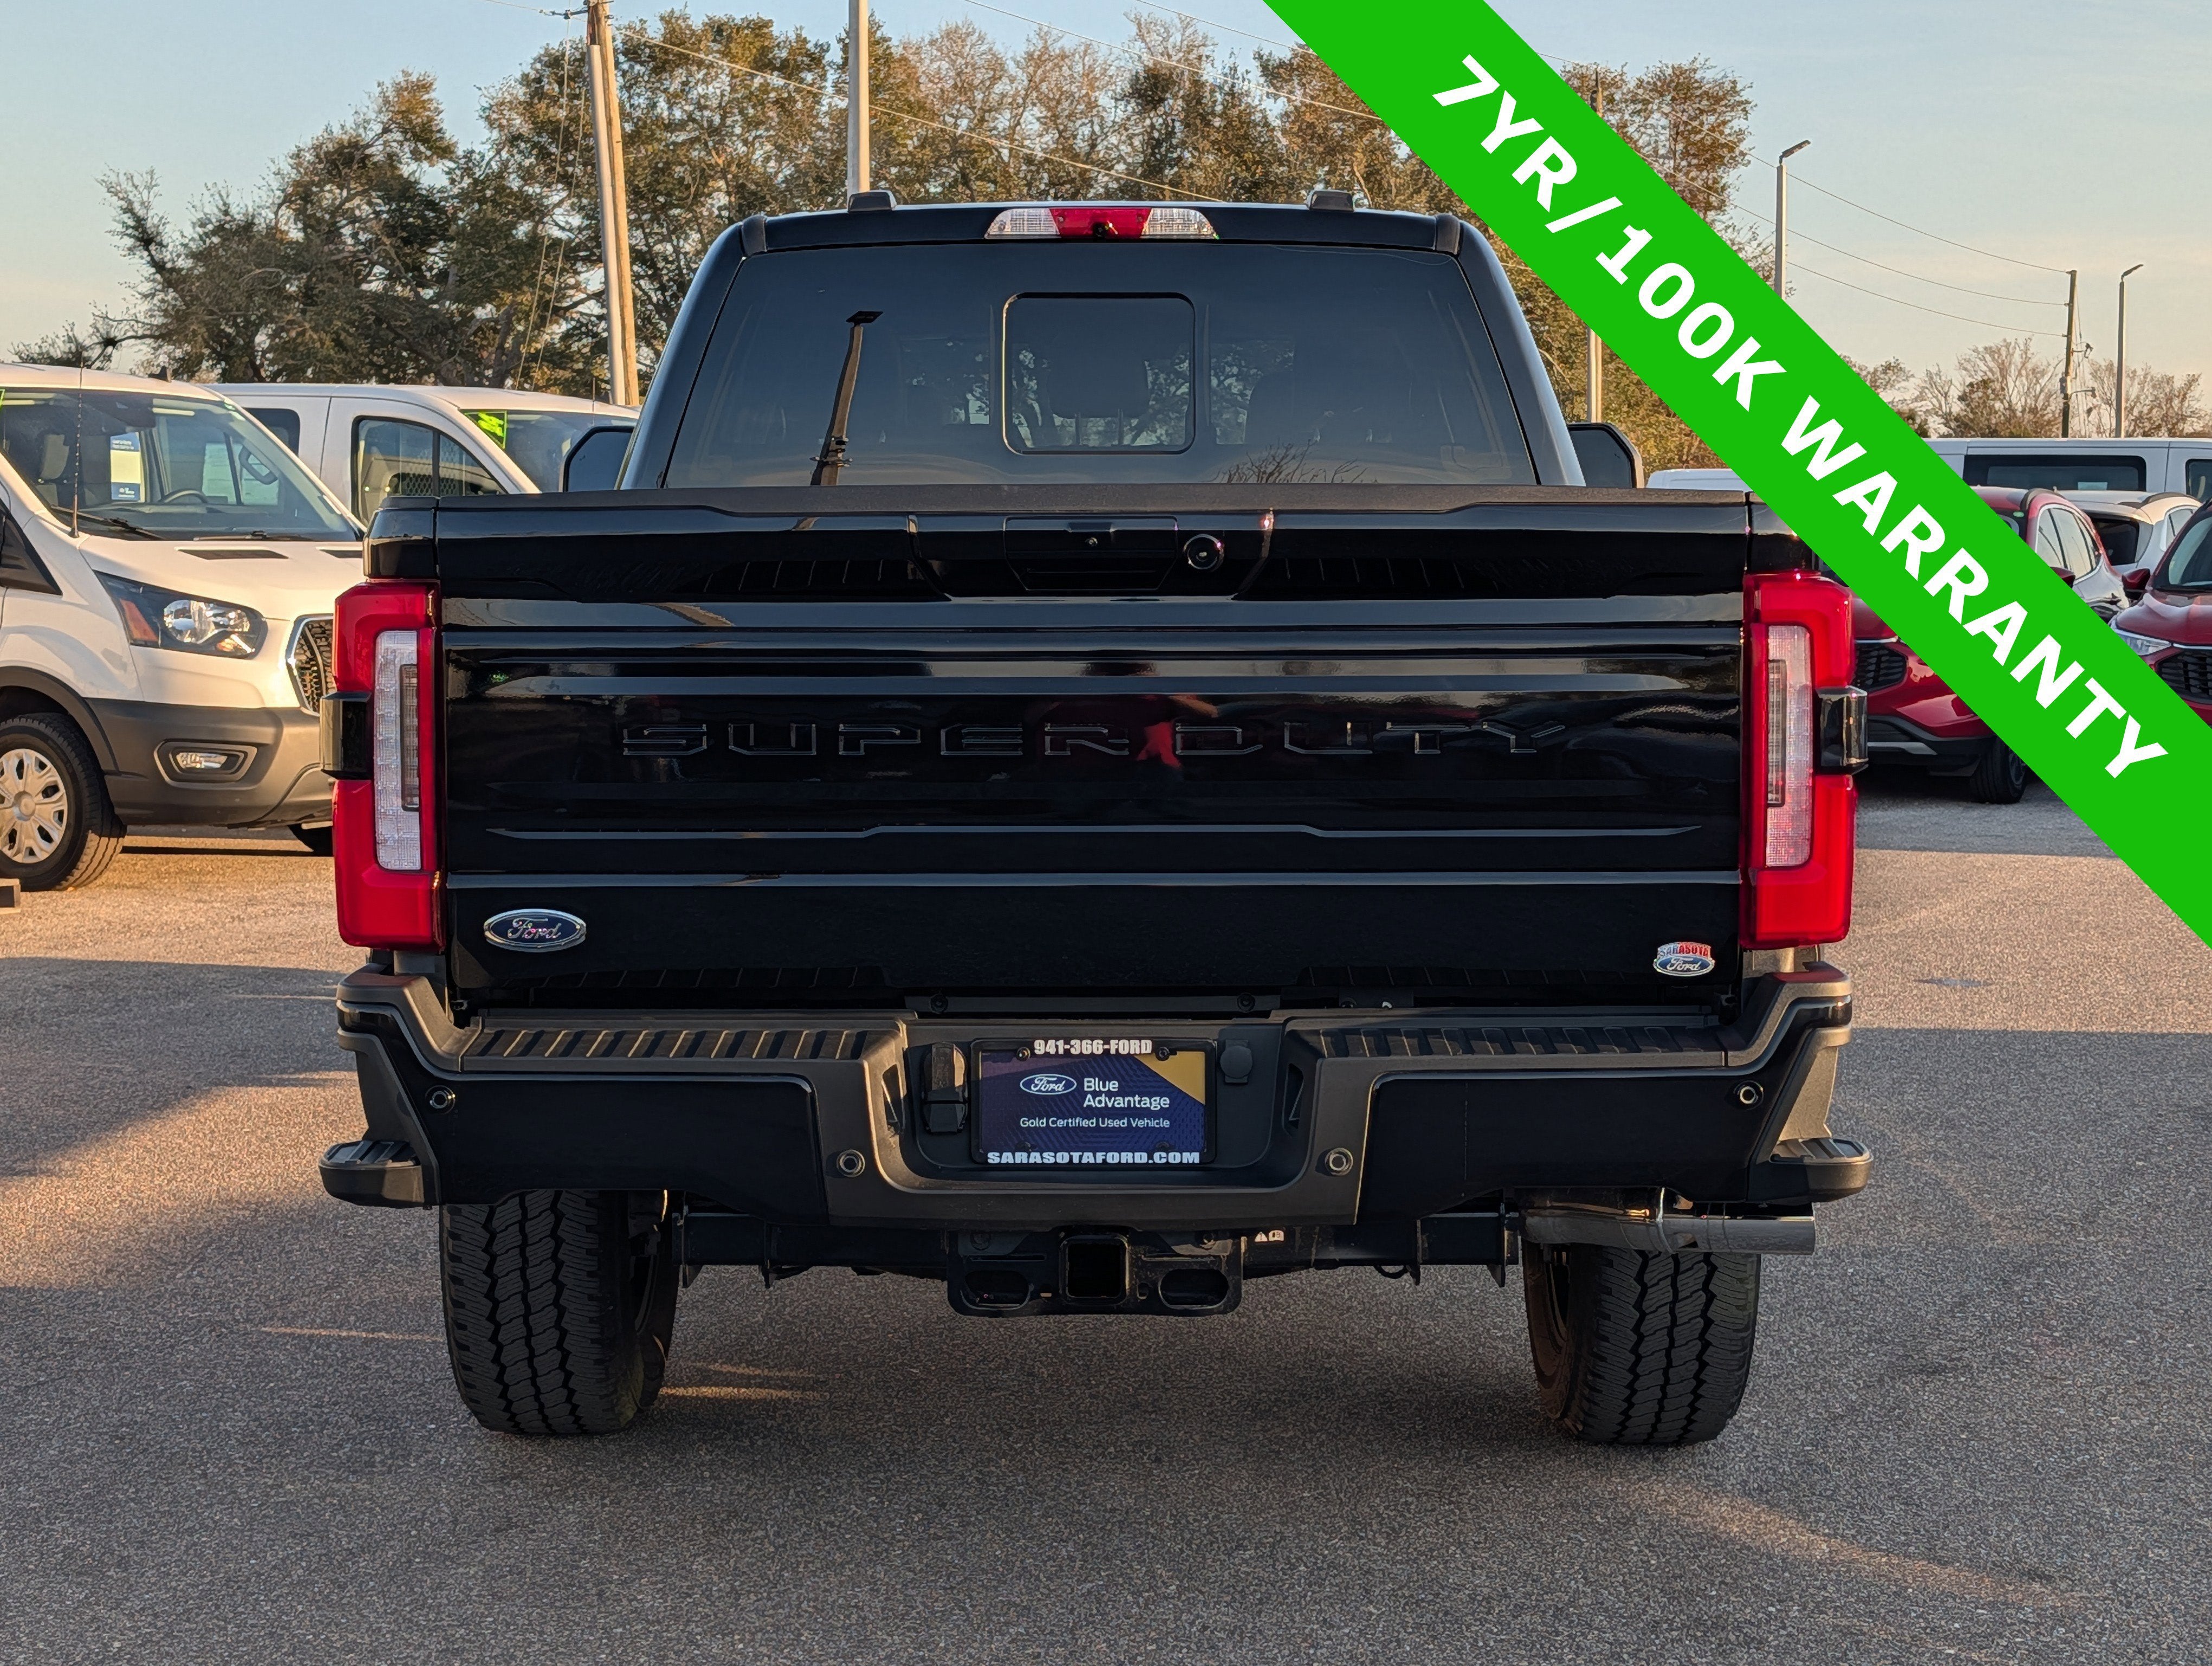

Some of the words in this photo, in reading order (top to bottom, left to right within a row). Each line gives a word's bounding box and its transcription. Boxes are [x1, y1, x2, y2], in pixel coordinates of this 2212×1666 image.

[623, 723, 1129, 755] SUPER
[1175, 721, 1566, 755] DUTY
[507, 917, 562, 939] Ford
[1657, 944, 1709, 958] SARASOTA
[1666, 957, 1702, 971] Ford
[1033, 1039, 1152, 1055] 941-366-FORD
[1031, 1076, 1065, 1092] Ford
[1084, 1077, 1118, 1092] Blue
[1083, 1093, 1170, 1111] Advantage
[1020, 1117, 1046, 1127] Gold
[1049, 1117, 1096, 1127] Certified
[1099, 1117, 1127, 1127] Used
[1130, 1117, 1170, 1127] Vehicle
[987, 1152, 1200, 1164] SARASOTAFORD.COM
